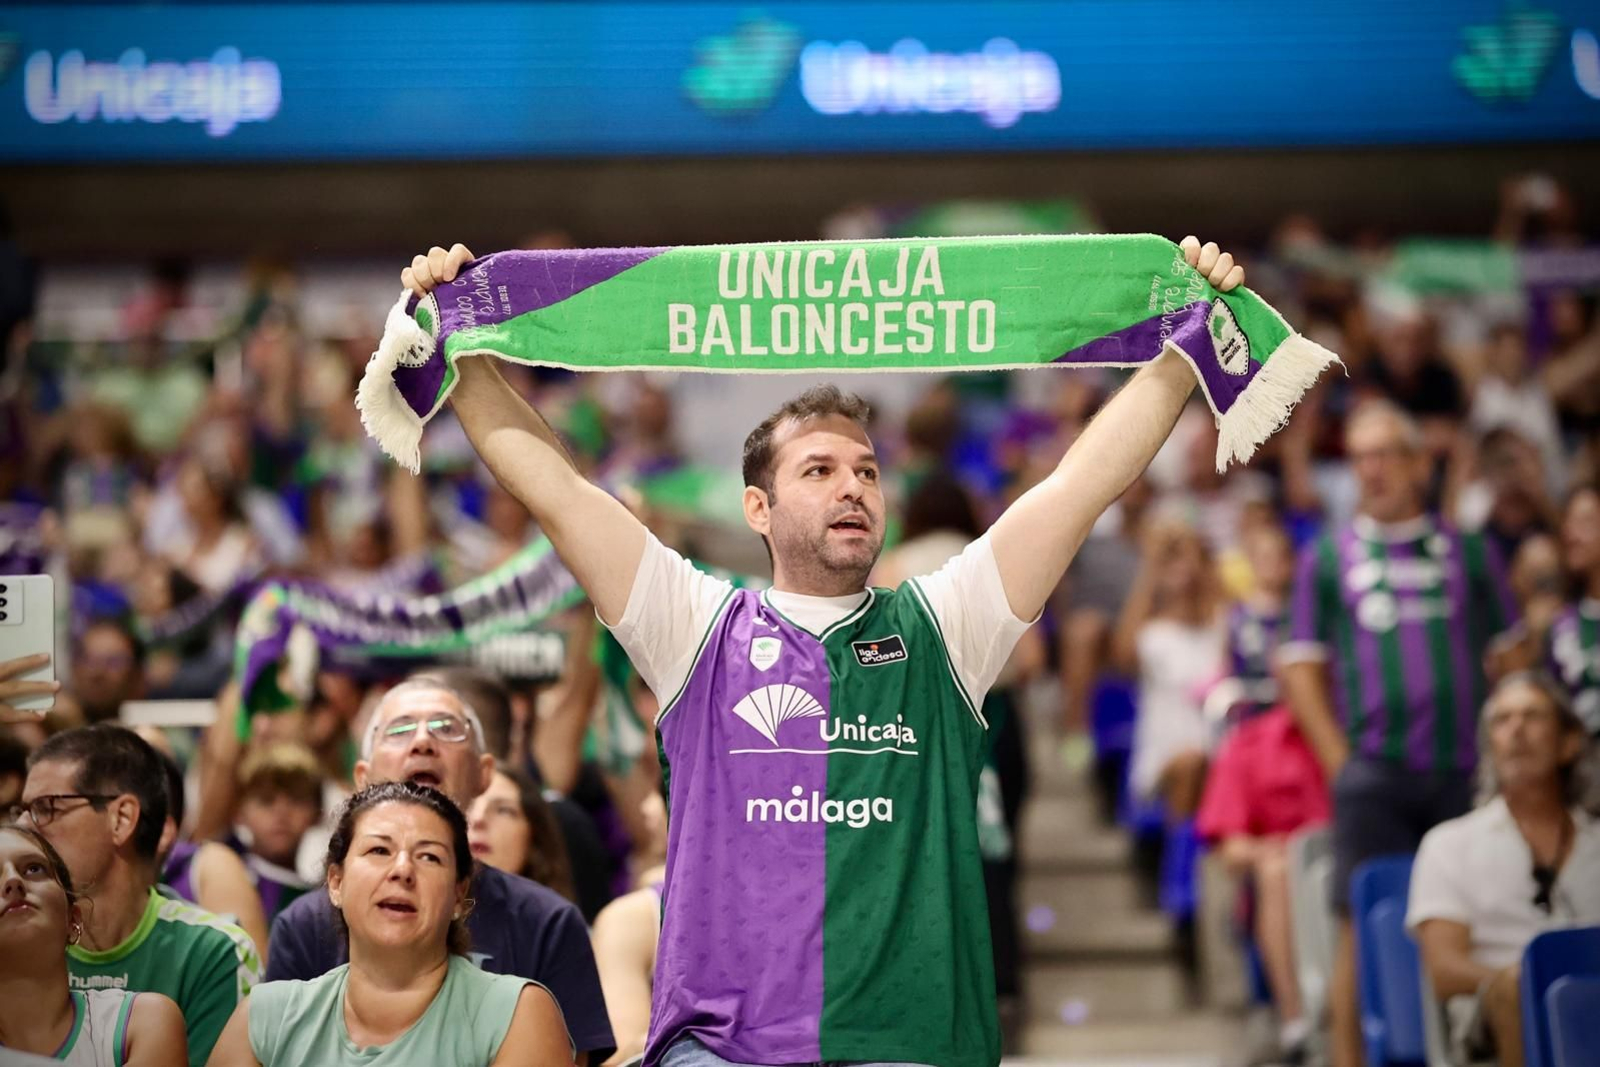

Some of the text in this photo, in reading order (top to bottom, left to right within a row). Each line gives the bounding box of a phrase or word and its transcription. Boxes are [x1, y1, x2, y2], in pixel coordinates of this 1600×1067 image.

[24, 46, 282, 137] Unicaja
[717, 246, 946, 299] UNICAJA
[668, 299, 996, 356] BALONCESTO
[858, 649, 879, 658] liga
[861, 650, 904, 663] endesa
[819, 714, 917, 747] Unicaja
[69, 972, 129, 989] hummel
